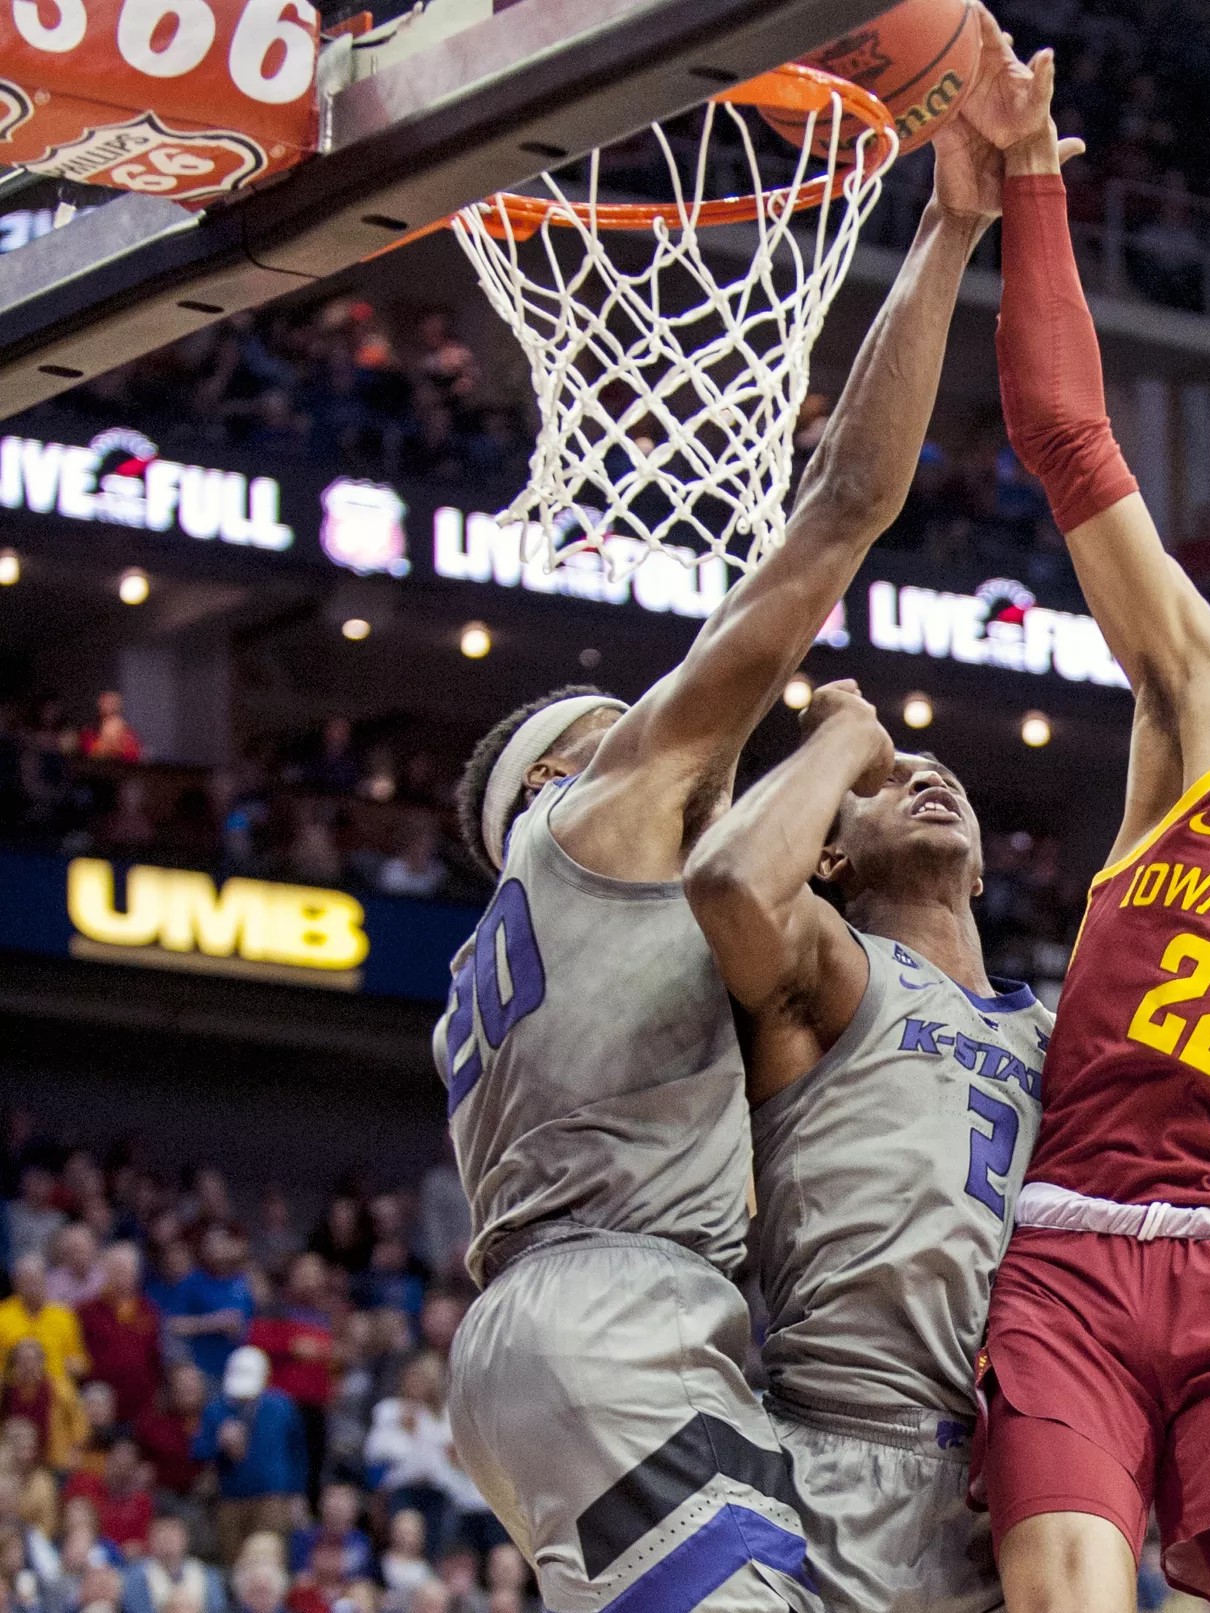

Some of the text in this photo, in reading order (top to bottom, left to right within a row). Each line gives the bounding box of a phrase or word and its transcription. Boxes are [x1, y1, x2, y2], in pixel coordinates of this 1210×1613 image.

[46, 132, 150, 181] PHILLIPS
[111, 147, 215, 192] 66
[0, 436, 97, 520] IVE
[145, 460, 294, 551] FULL
[433, 506, 560, 594] LIVE
[869, 580, 989, 664] LIVE
[1023, 606, 1132, 690] FUL
[67, 857, 370, 970] UMB
[898, 1017, 1043, 1101] K-STAT
[964, 1083, 1020, 1222] 2
